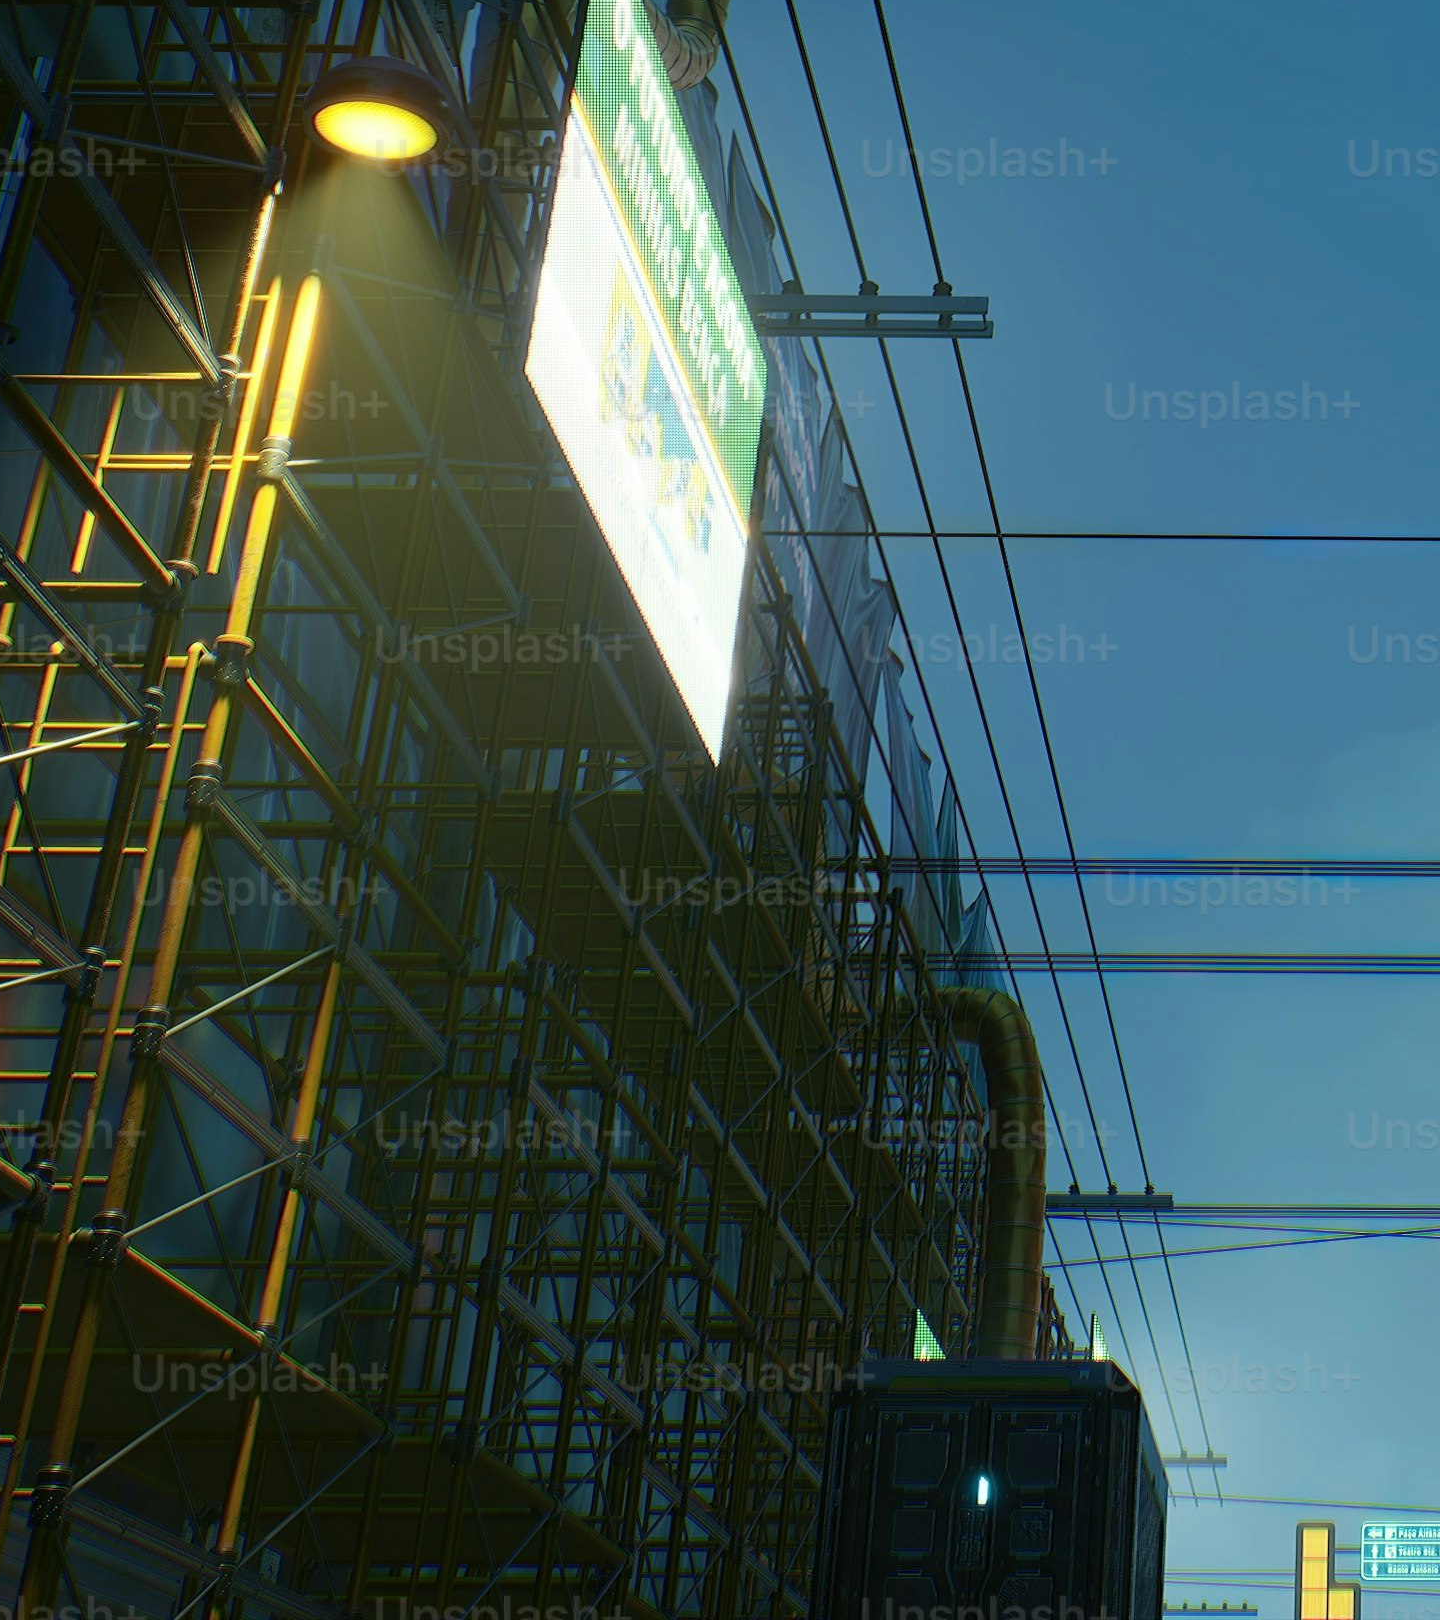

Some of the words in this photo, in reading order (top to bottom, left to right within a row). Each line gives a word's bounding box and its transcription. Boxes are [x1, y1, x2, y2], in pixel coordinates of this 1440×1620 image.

[613, 103, 681, 298] MINHAS
[629, 36, 696, 231] FUTURO
[706, 251, 753, 400] AGORA
